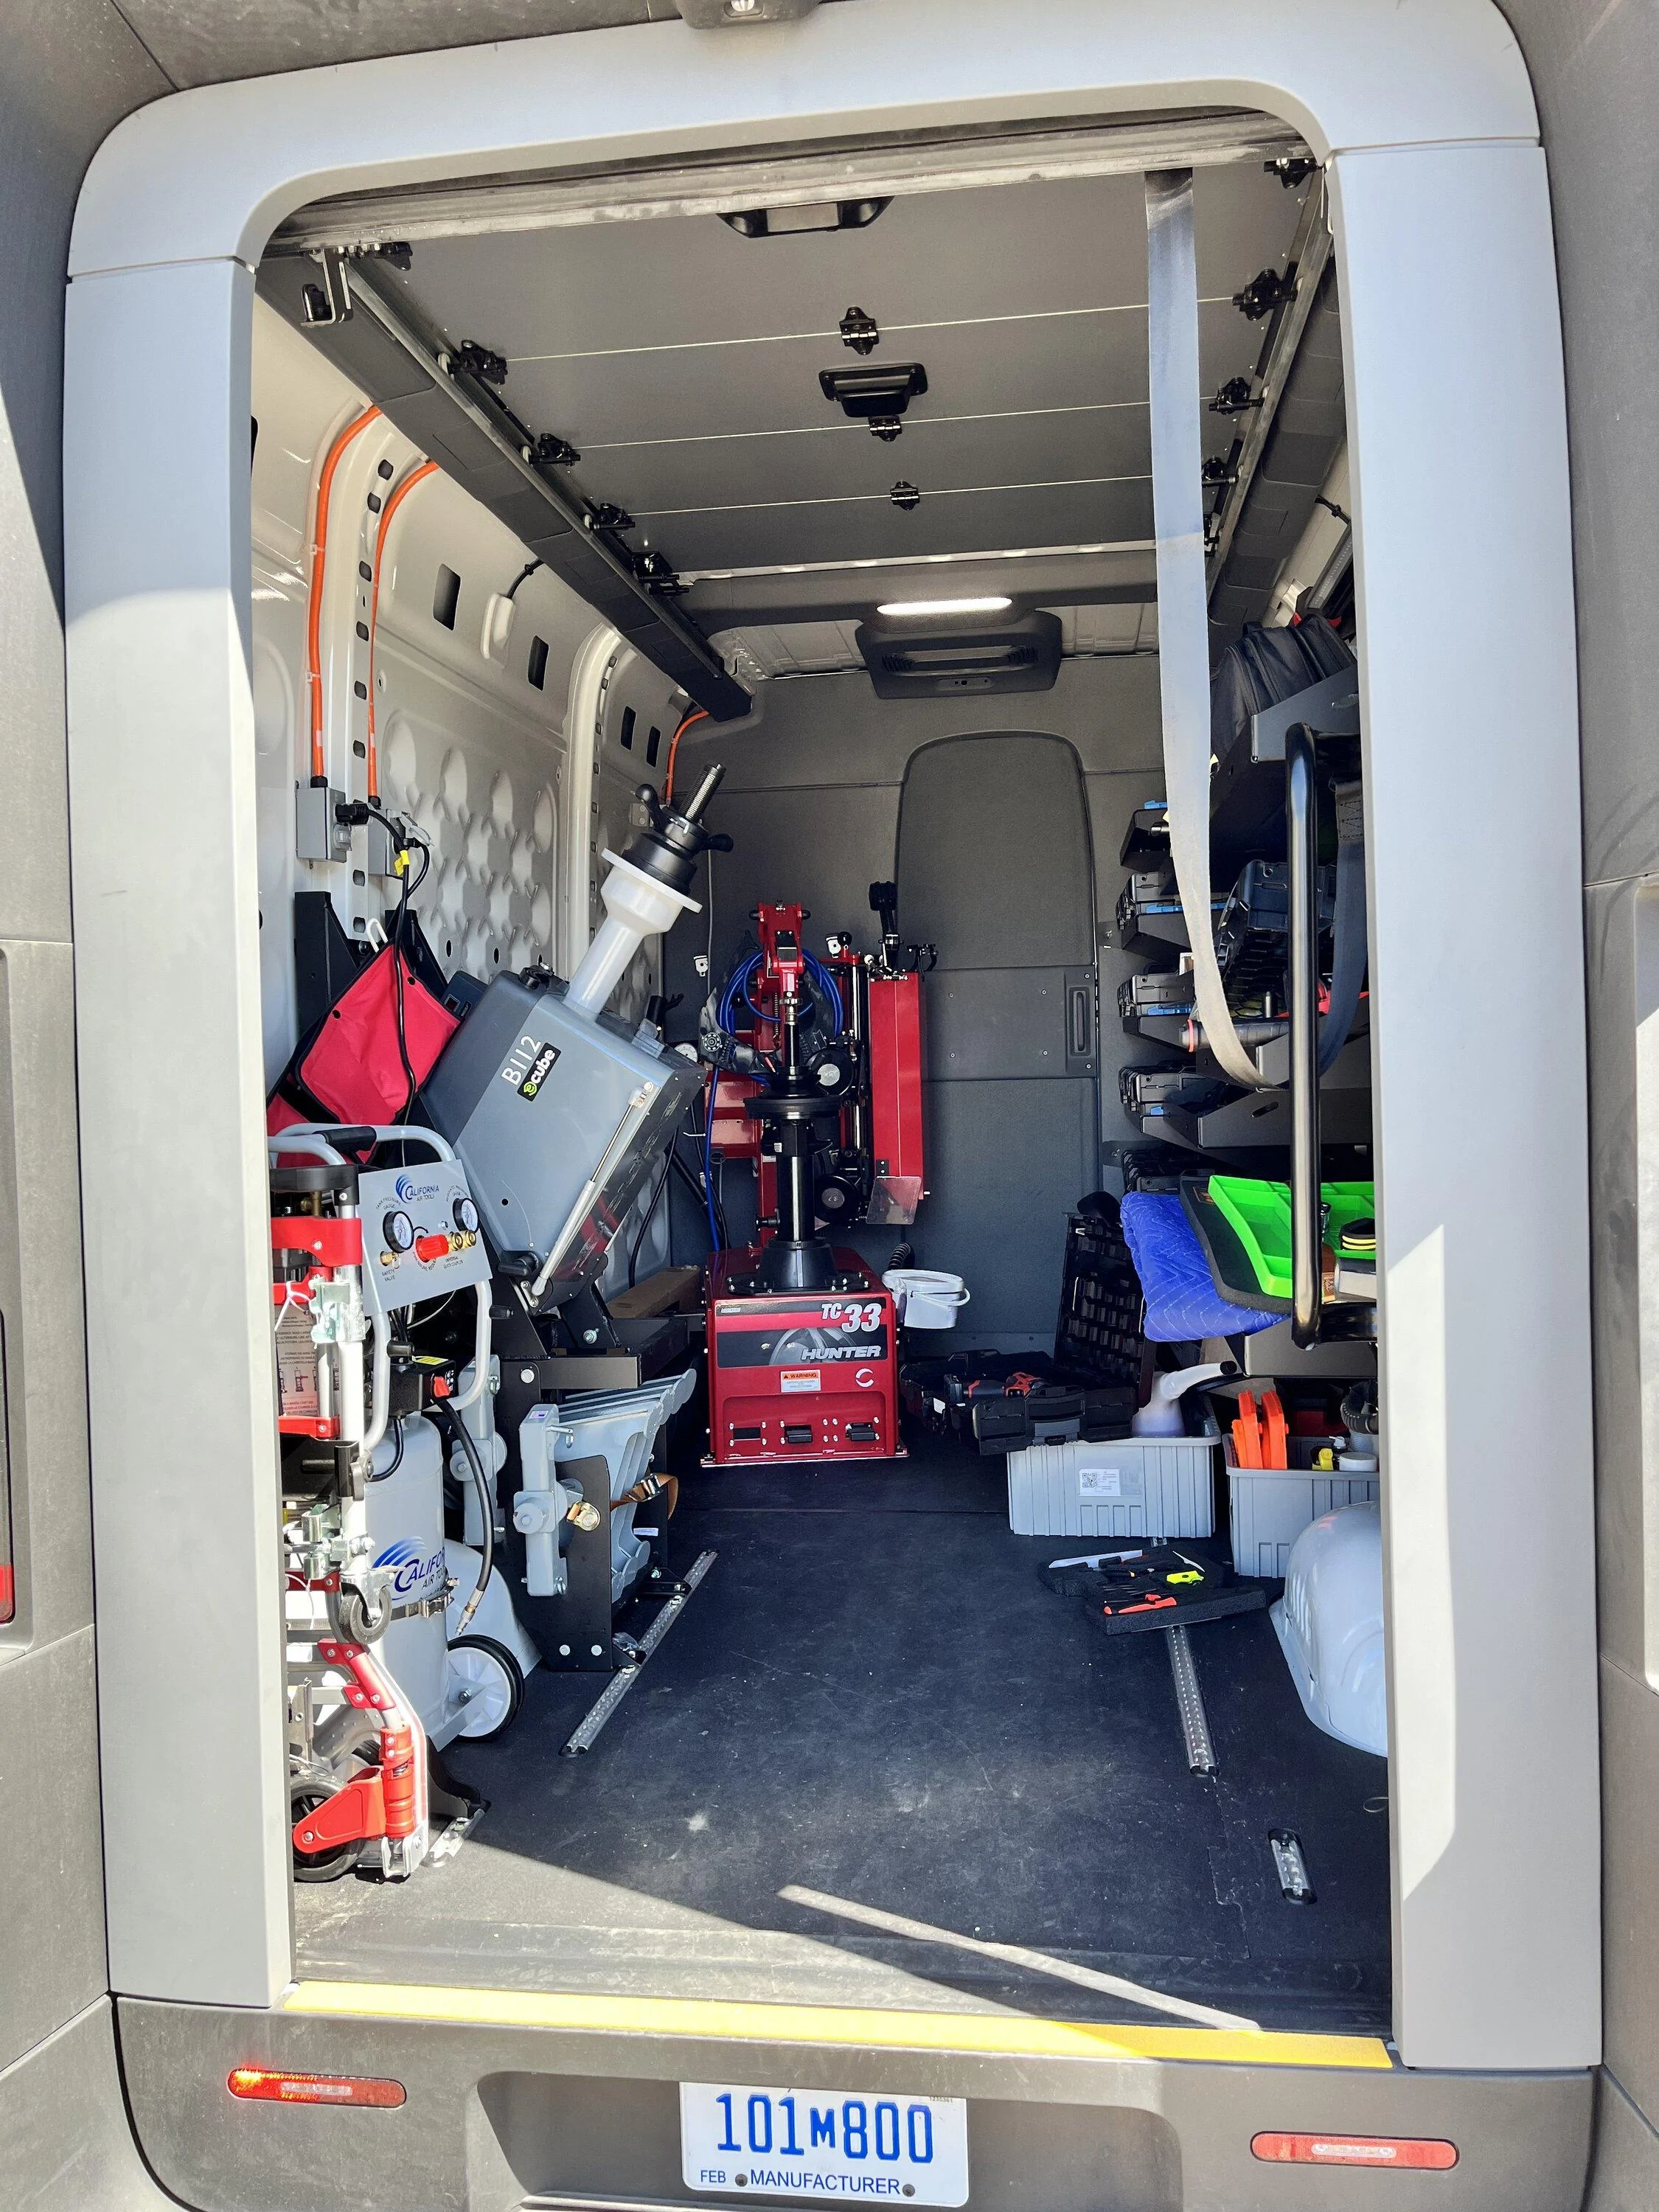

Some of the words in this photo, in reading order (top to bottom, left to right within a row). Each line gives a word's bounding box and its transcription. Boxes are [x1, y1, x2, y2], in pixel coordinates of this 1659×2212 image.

[405, 1185, 439, 1200] CALIFORNIA
[801, 1346, 881, 1361] HUNTER
[422, 1574, 434, 1590] AIR
[715, 2093, 934, 2164] 101M800
[700, 2169, 726, 2184] FEB
[750, 2168, 900, 2195] MANUFACTURER
